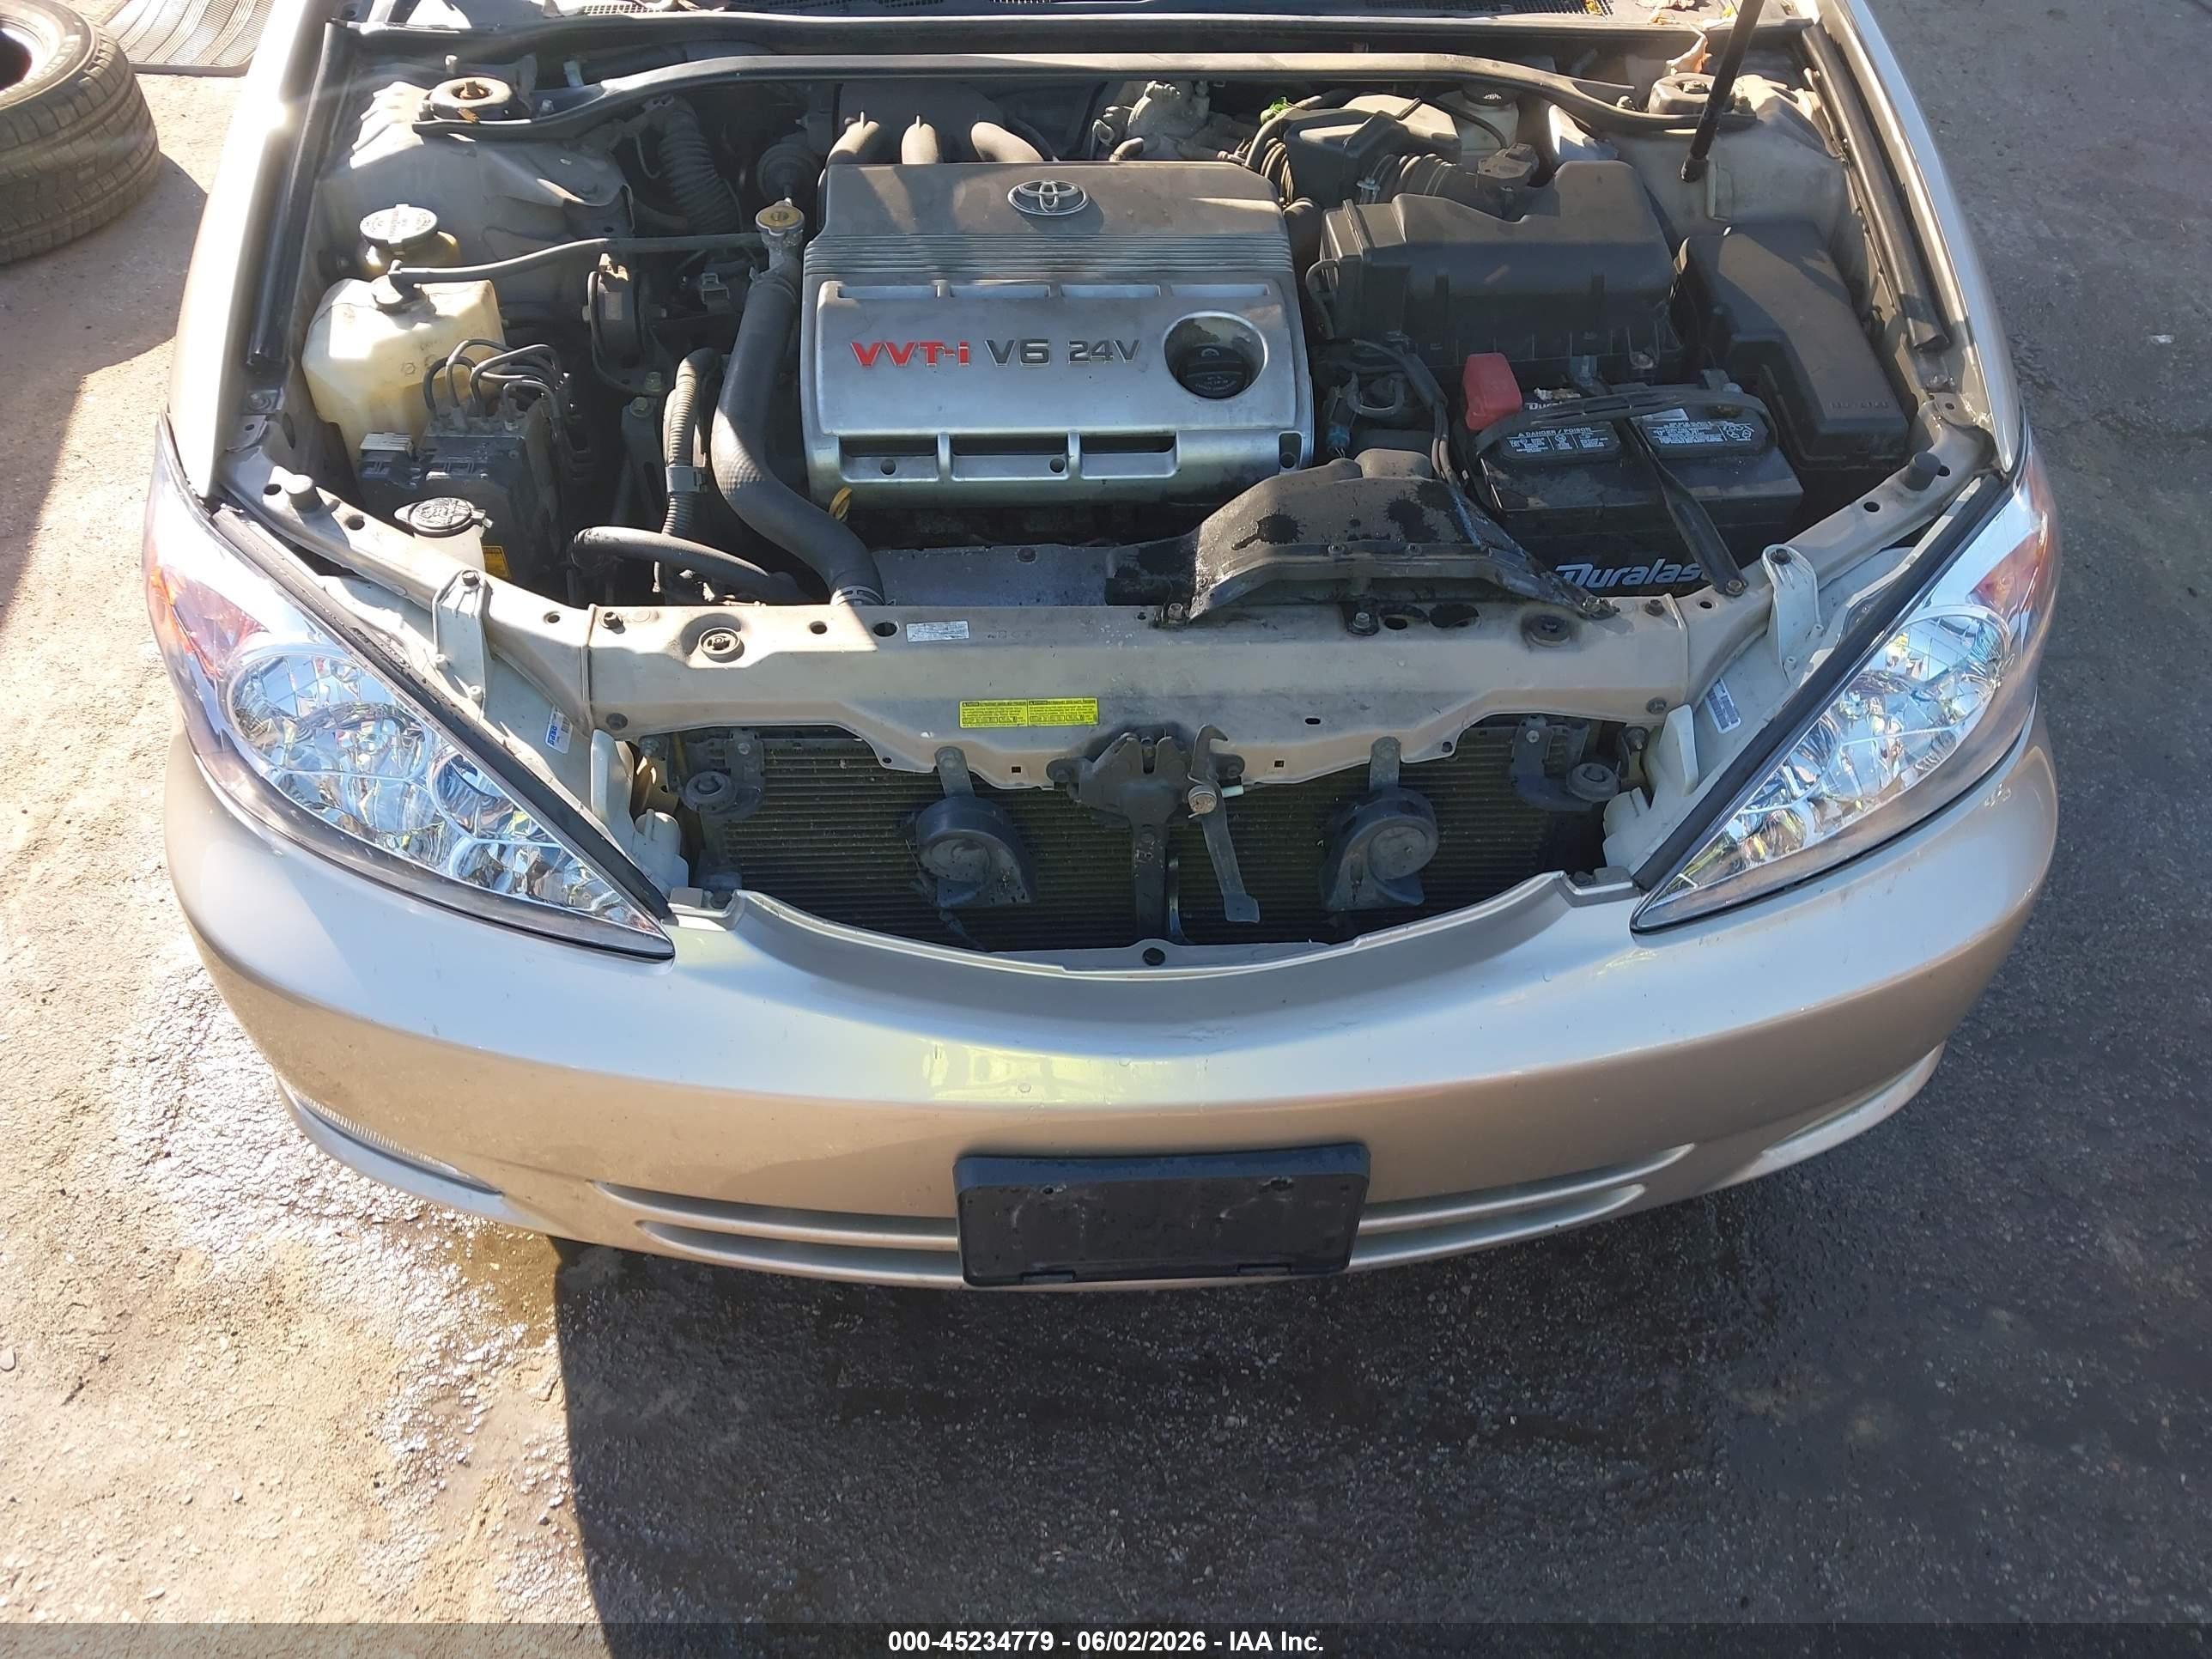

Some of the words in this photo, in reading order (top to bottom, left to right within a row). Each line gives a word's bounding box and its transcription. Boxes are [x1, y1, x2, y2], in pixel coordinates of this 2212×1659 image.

[851, 341, 969, 367] VVT-i
[985, 338, 1050, 367] V6
[1067, 339, 1139, 364] 24V
[1555, 558, 1703, 589] Duralas
